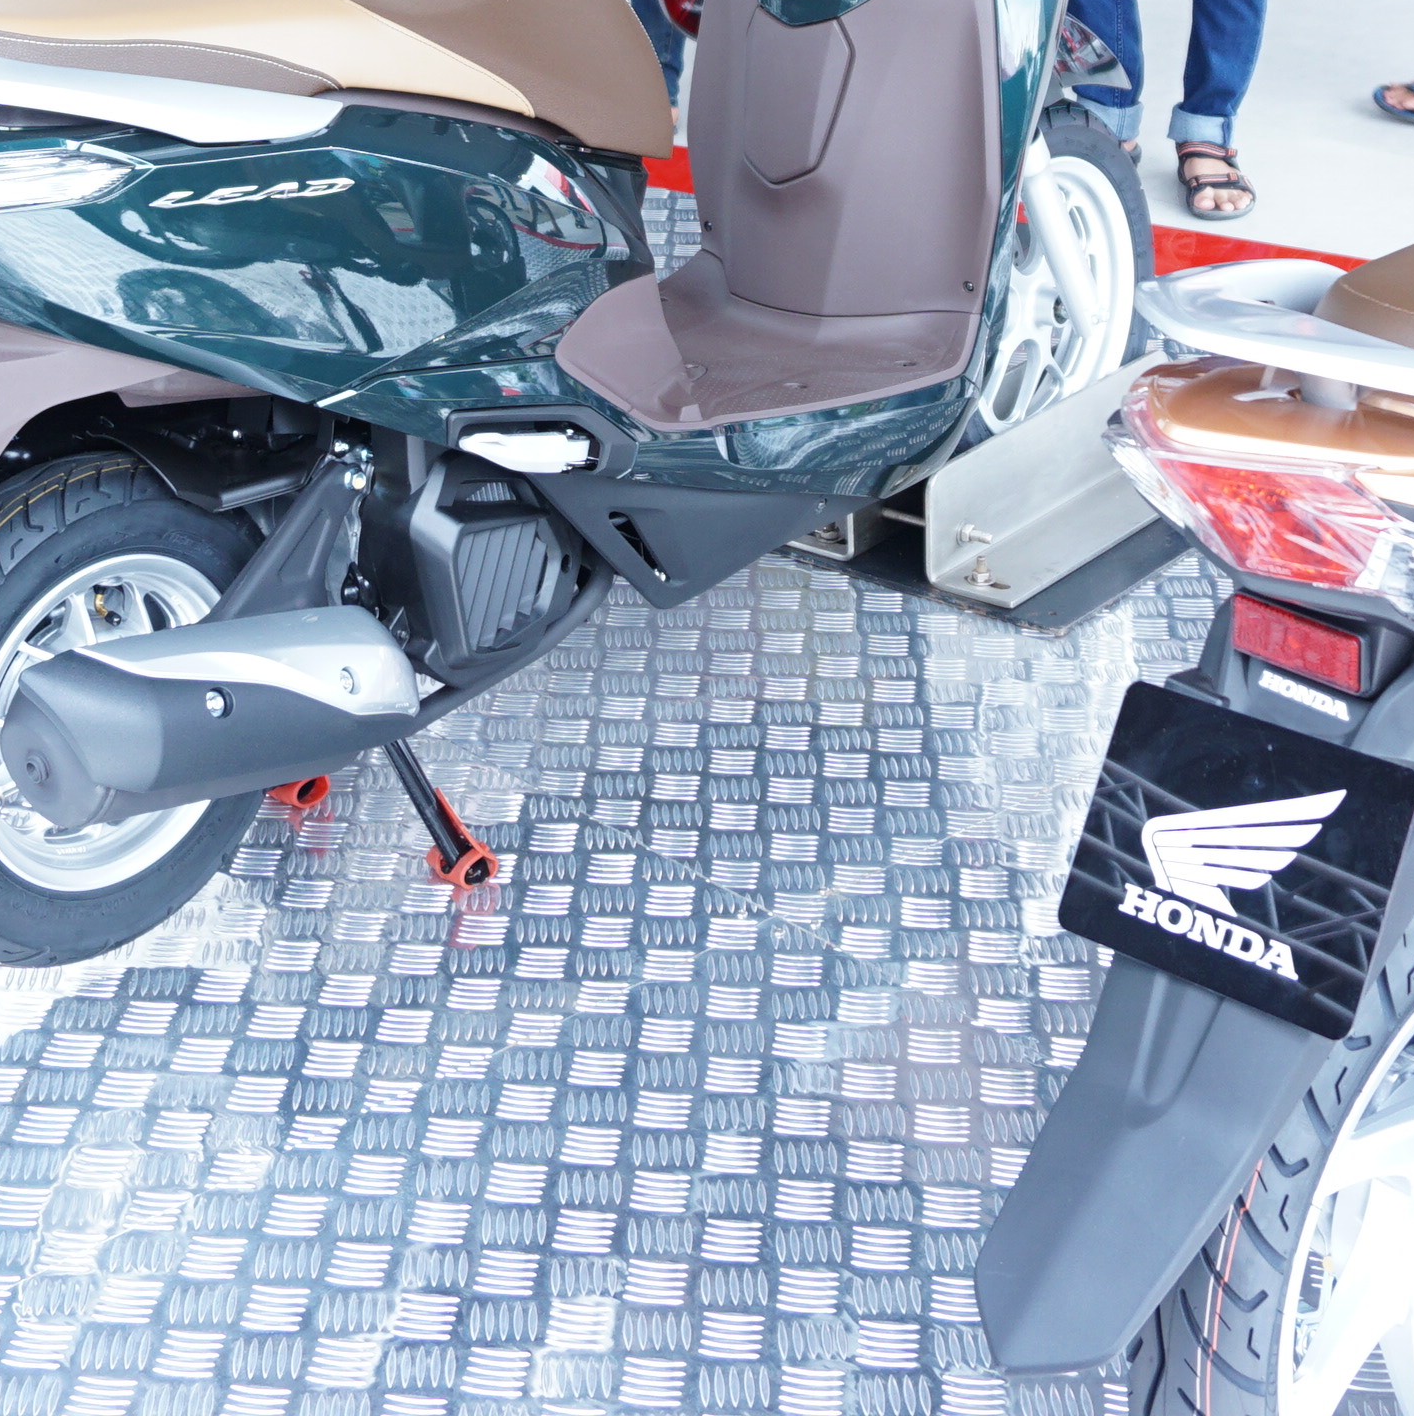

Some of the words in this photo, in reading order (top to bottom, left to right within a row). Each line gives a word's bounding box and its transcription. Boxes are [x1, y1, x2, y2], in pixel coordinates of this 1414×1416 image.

[148, 177, 355, 209] LEAD
[1258, 669, 1350, 721] HONDA
[1118, 882, 1299, 980] HONDA
